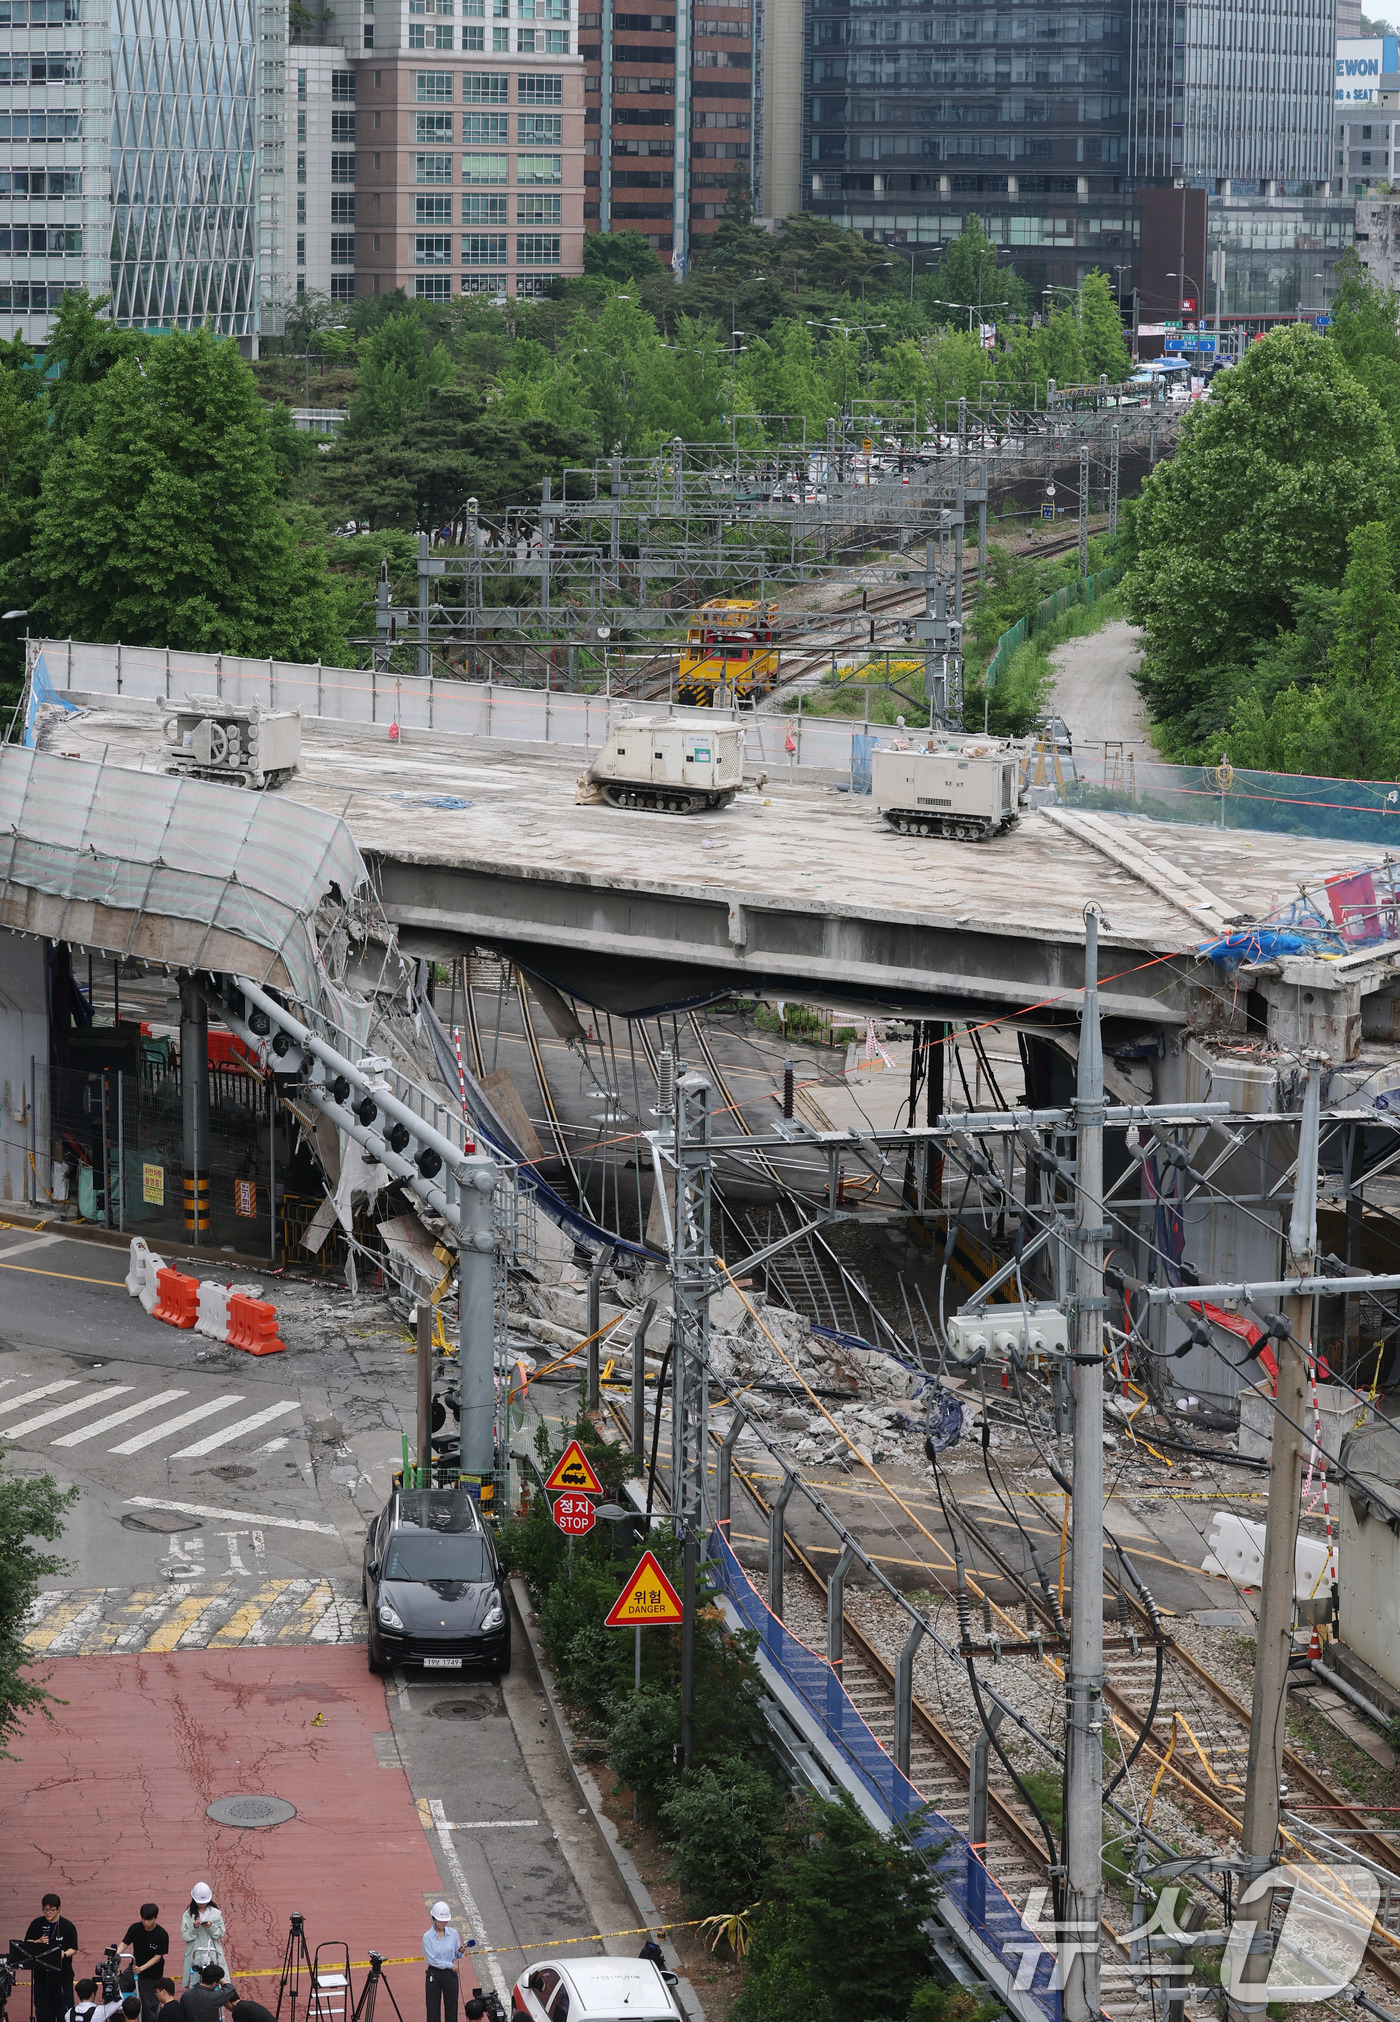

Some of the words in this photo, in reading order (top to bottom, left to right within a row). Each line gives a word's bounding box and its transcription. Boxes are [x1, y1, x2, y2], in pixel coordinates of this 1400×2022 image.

[1353, 89, 1373, 101] SEAT
[560, 1500, 589, 1515] 정지
[559, 1517, 589, 1530] STOP
[633, 1590, 661, 1605] 위험
[628, 1605, 666, 1614] DANGER
